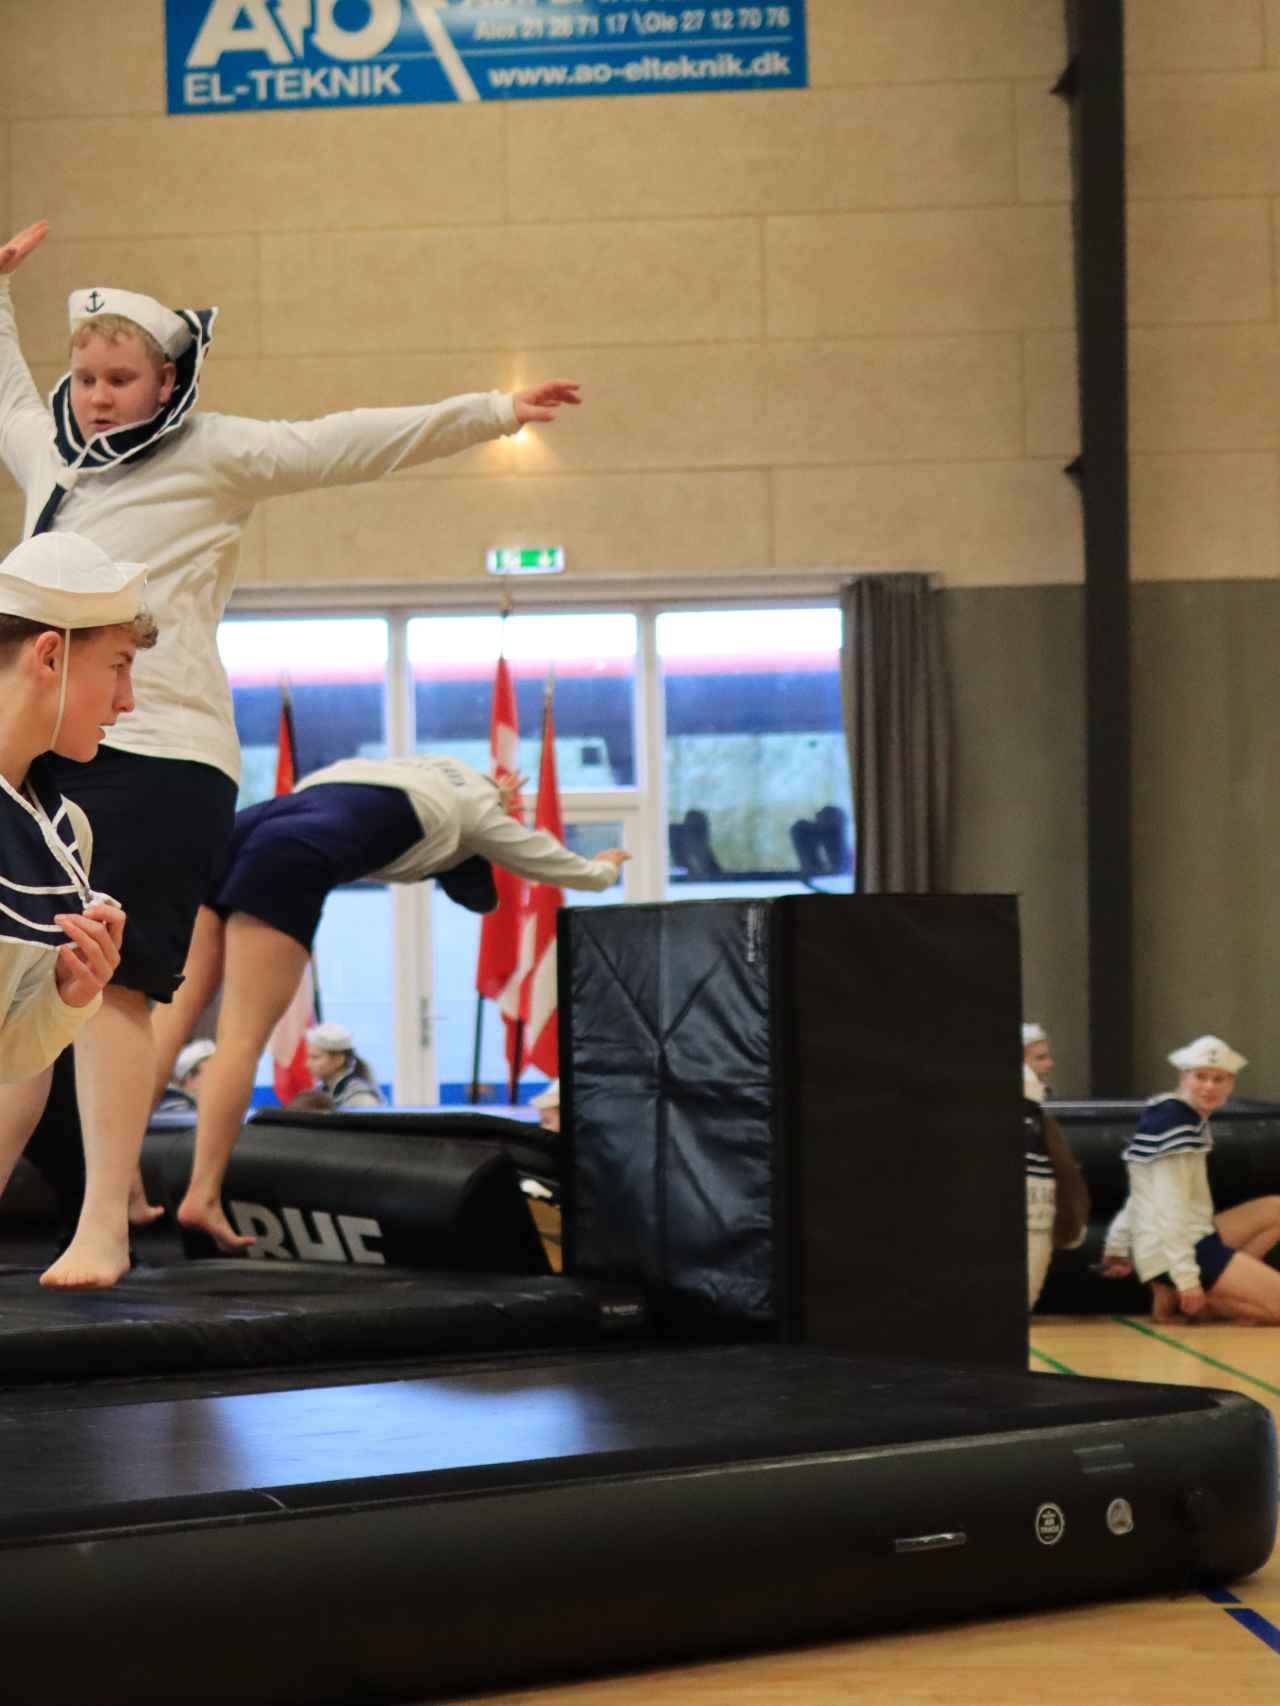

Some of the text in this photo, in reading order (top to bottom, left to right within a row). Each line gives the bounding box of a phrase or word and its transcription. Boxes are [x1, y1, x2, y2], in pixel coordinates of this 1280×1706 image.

[710, 7, 735, 31] 12
[183, 63, 402, 106] EL-TEKNIK
[488, 52, 792, 89] www.ao-elteknik.dk
